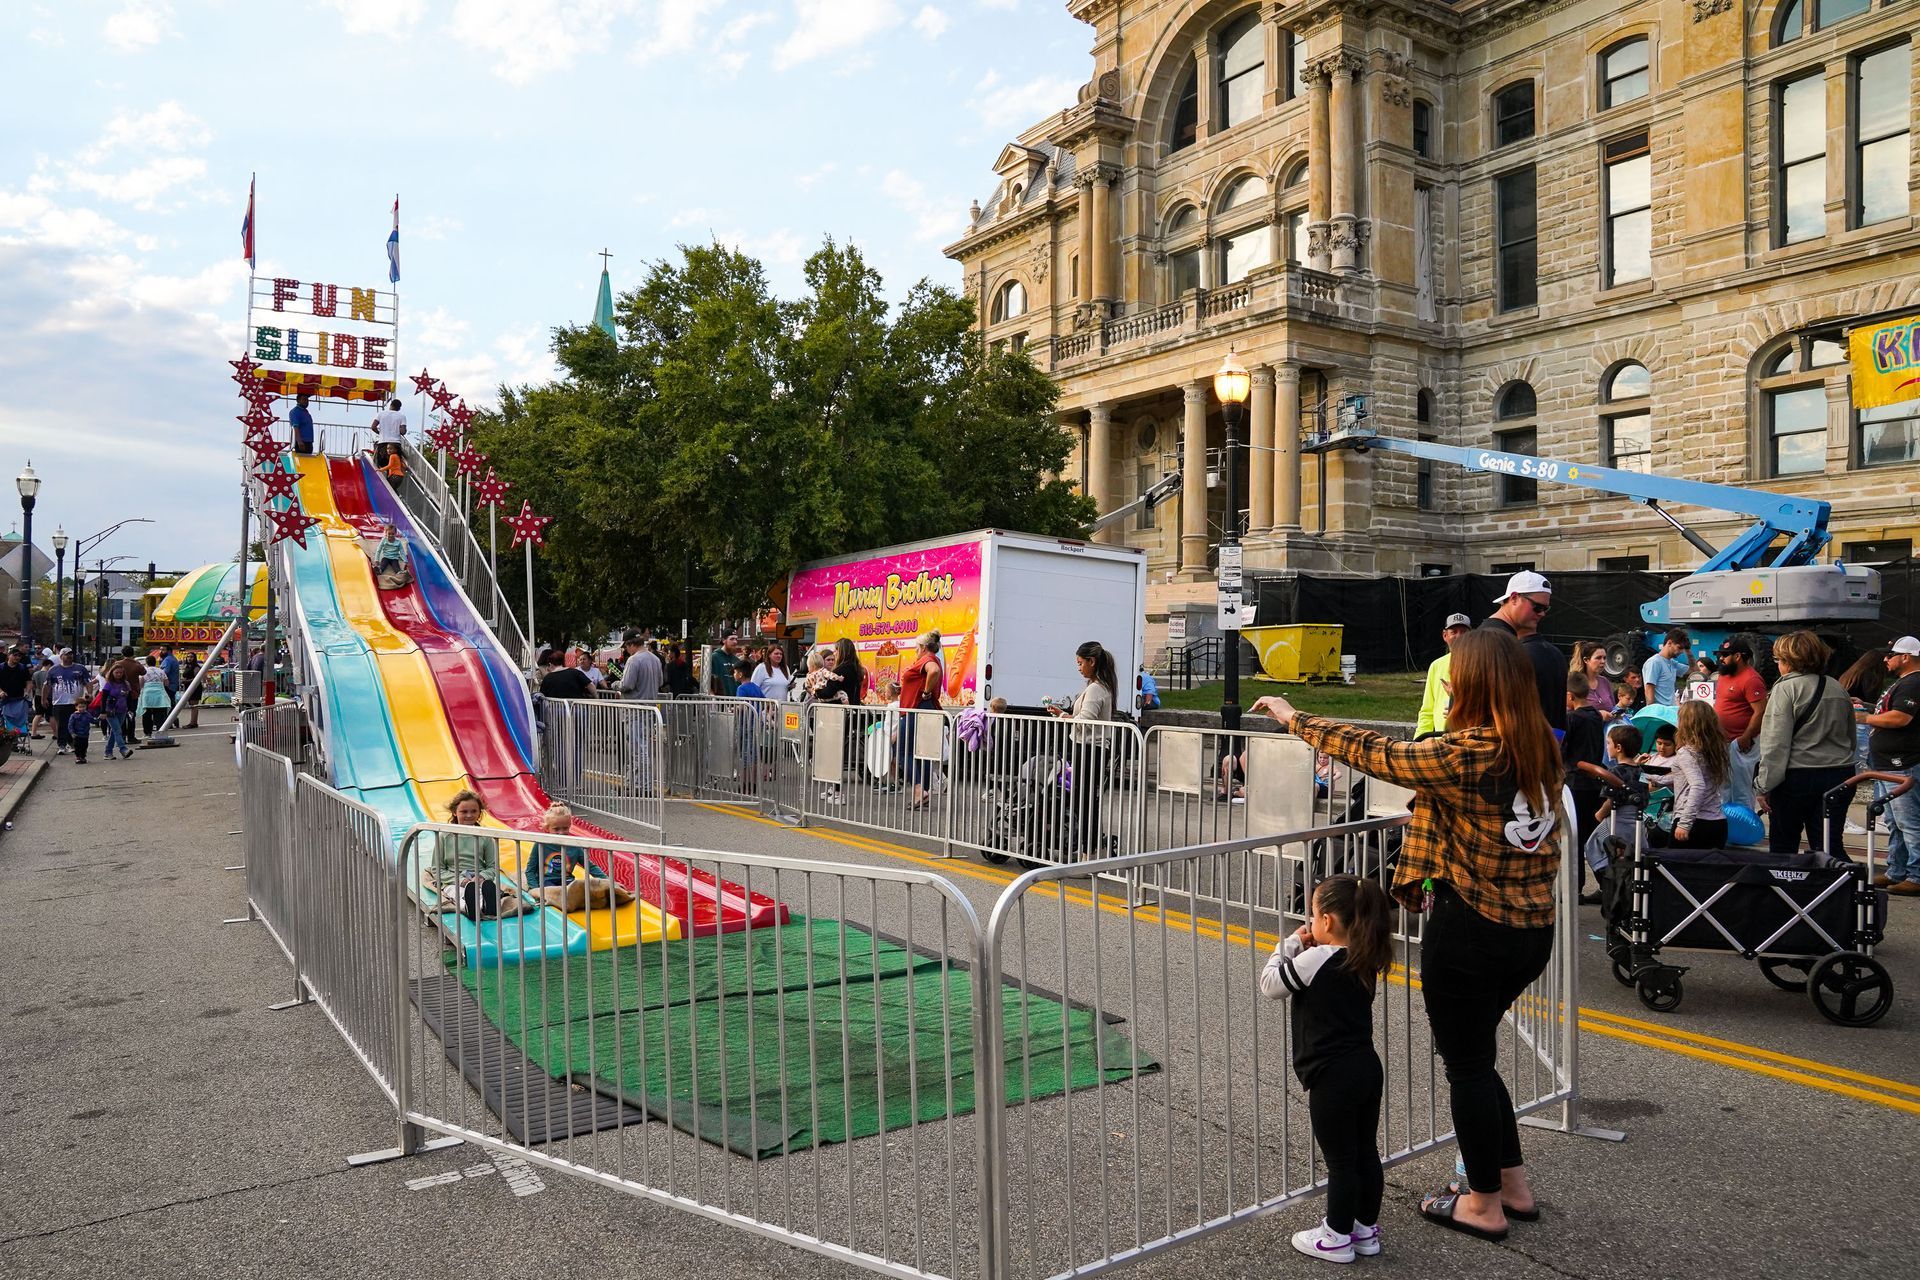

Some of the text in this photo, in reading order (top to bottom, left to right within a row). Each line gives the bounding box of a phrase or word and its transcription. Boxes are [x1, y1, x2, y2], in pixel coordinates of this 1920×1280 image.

[273, 277, 376, 322] FUN
[256, 325, 388, 371] SLIDE
[1479, 452, 1558, 479] Genie S-80
[833, 570, 955, 619] Murray Brothers
[1741, 596, 1773, 605] SUNBELT
[786, 715, 798, 726] EXIT
[1777, 870, 1803, 879] KEENZ
